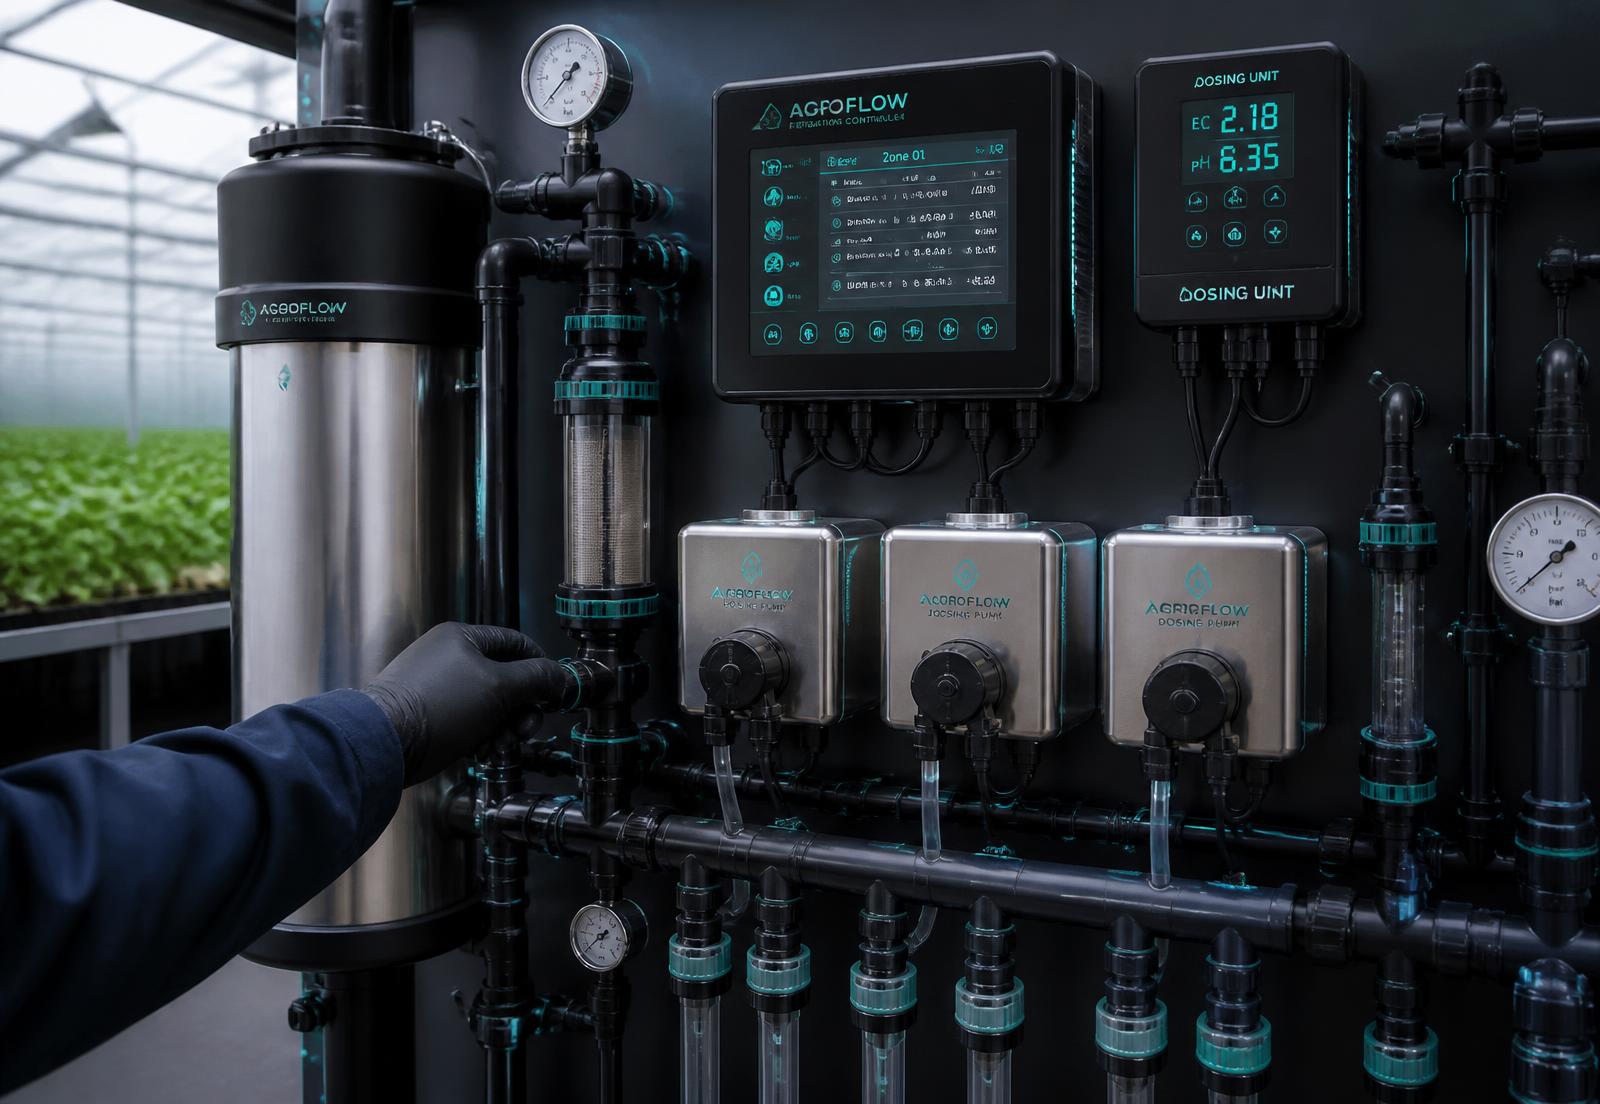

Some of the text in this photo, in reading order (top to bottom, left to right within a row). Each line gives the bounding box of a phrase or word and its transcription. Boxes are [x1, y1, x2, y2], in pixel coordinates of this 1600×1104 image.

[1249, 70, 1279, 83] UNIT
[1191, 102, 1278, 133] EC 2.18
[912, 149, 925, 161] 01
[1191, 155, 1210, 172] pH
